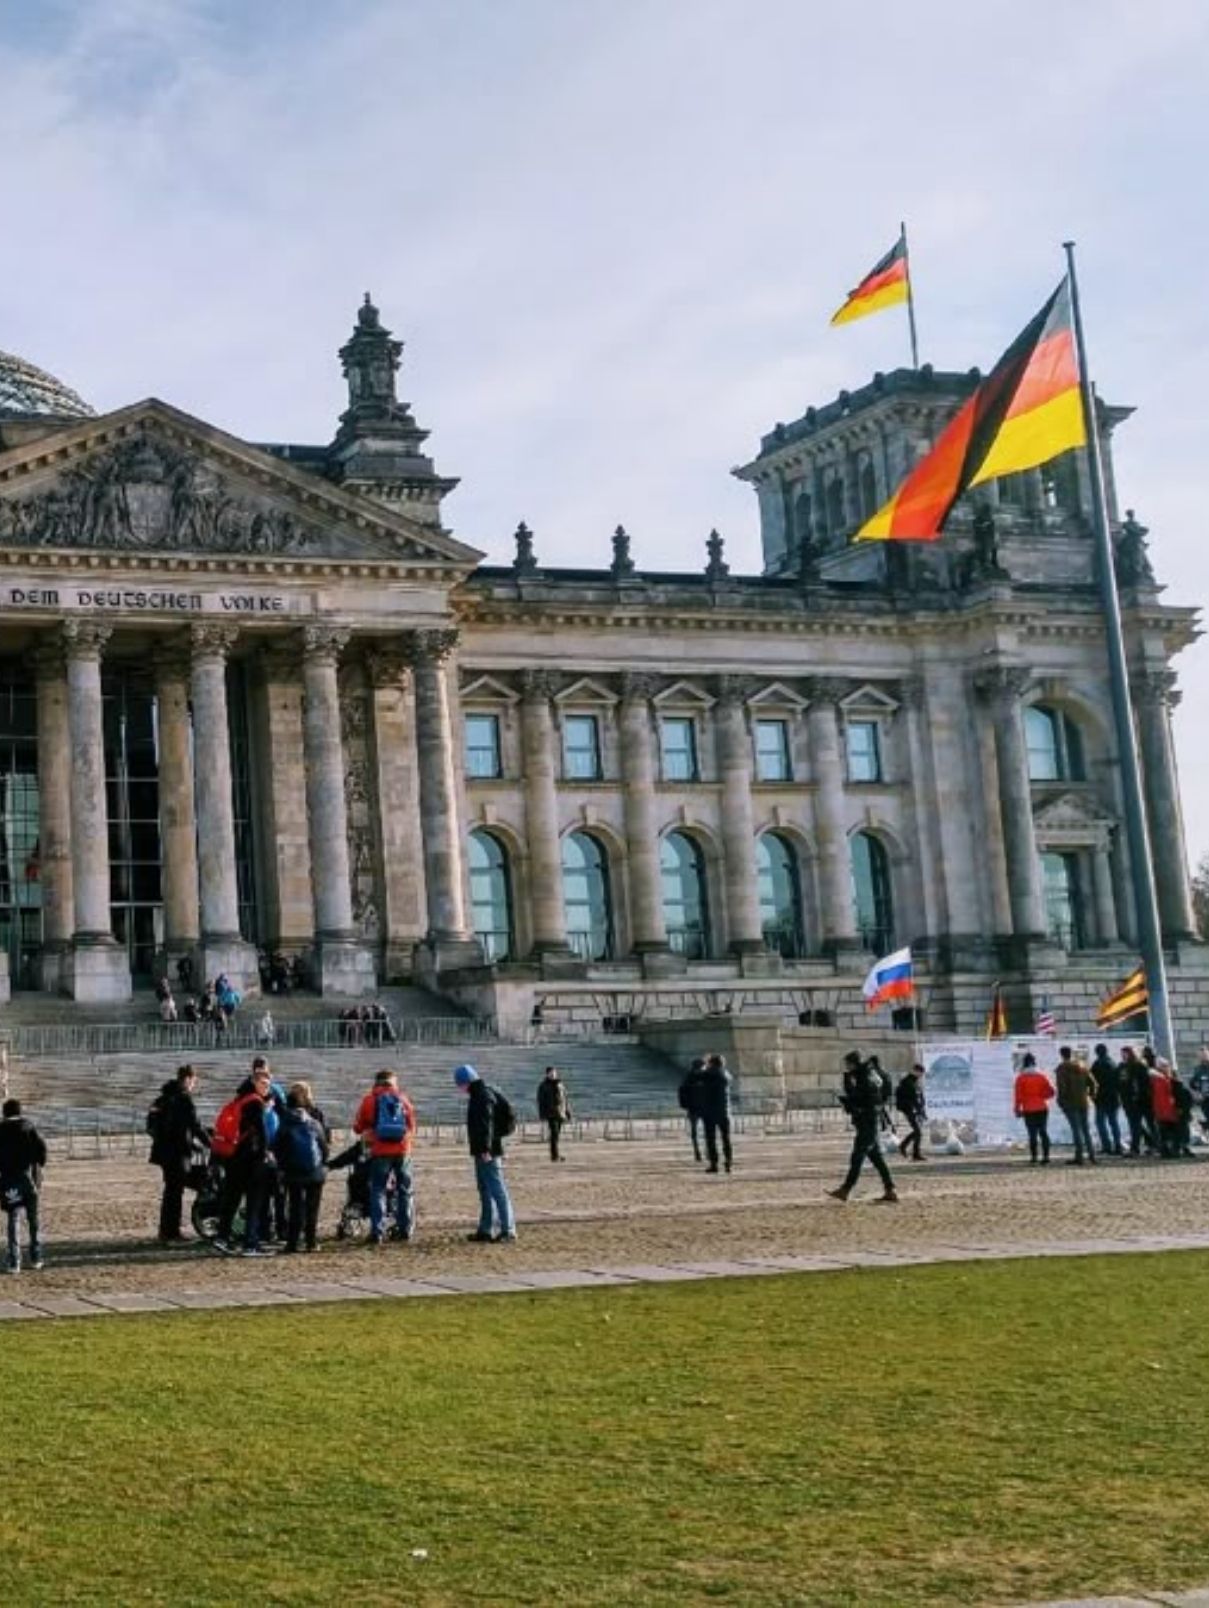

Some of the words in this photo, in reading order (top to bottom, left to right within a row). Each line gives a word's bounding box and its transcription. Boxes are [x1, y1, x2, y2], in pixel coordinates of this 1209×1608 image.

[10, 588, 59, 605] DEM
[77, 591, 202, 609] DEUTSCHEN
[220, 594, 284, 611] VOLKE
